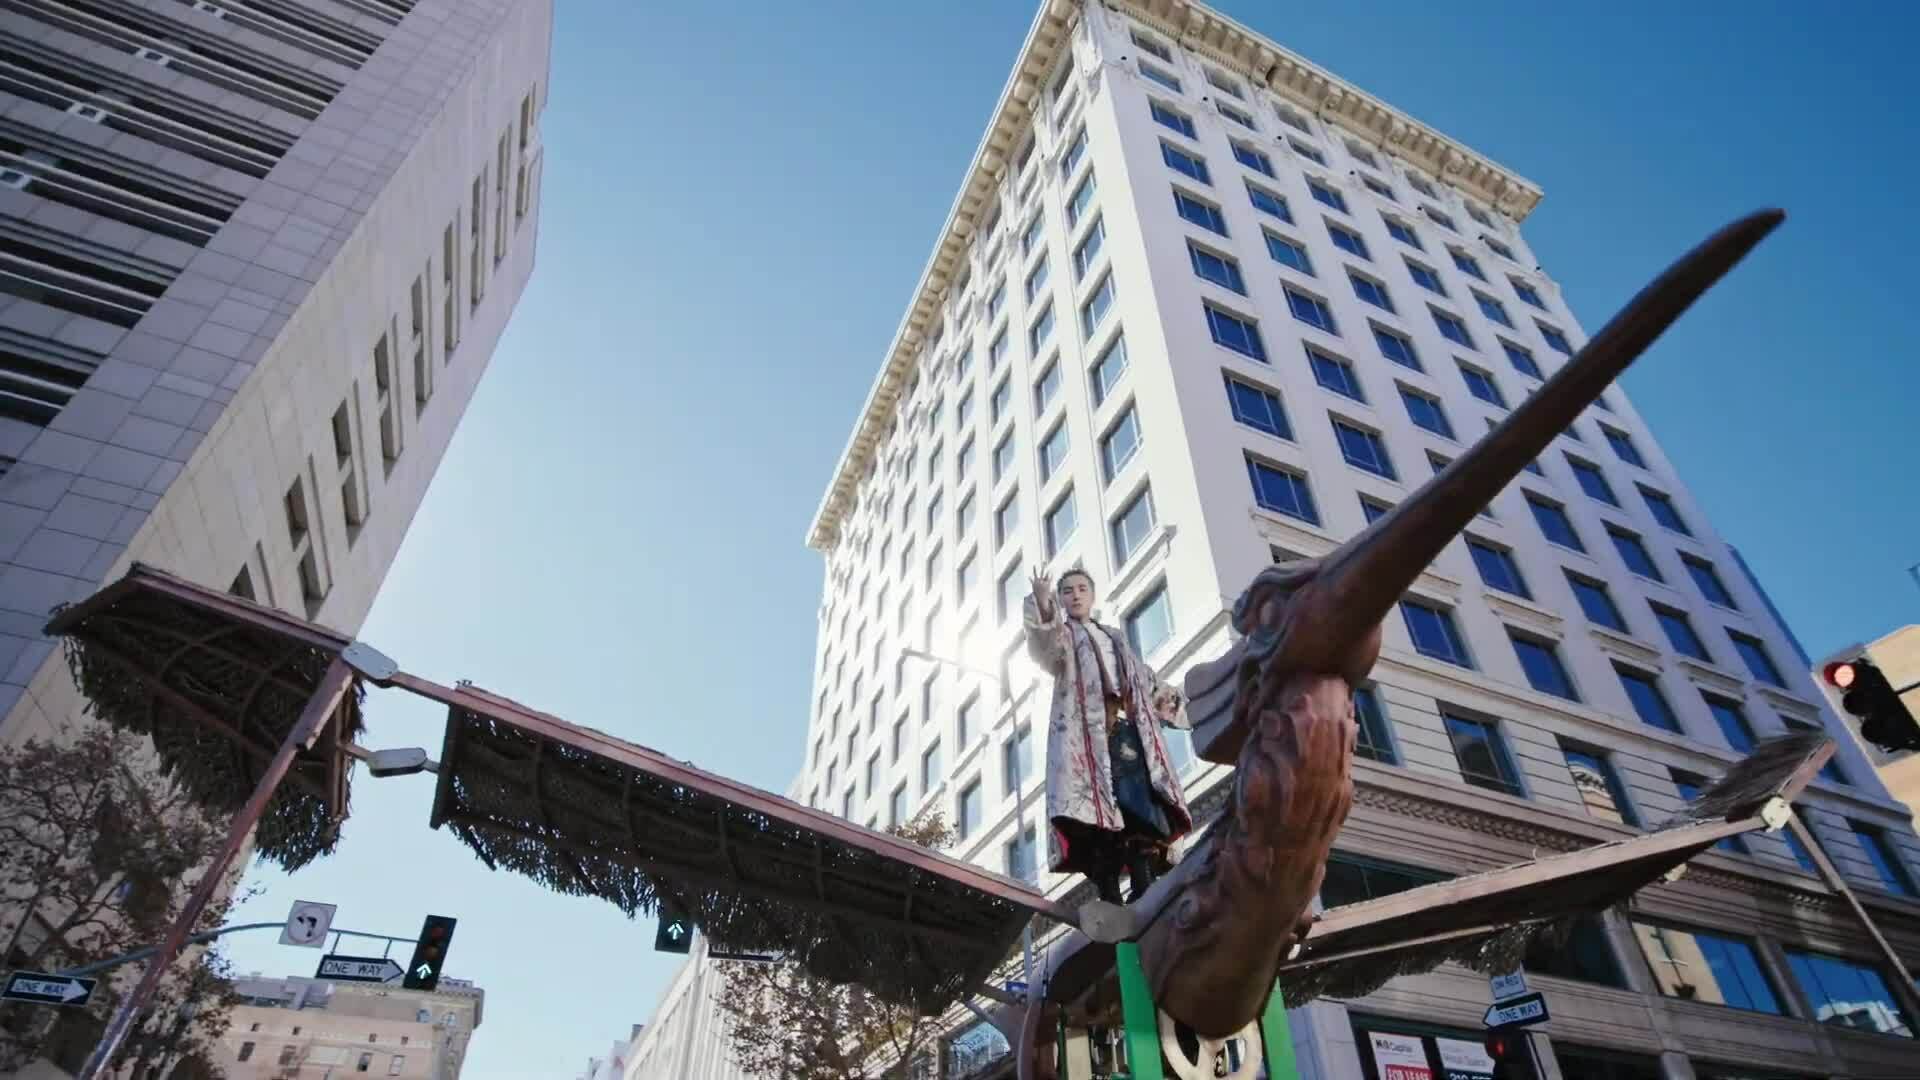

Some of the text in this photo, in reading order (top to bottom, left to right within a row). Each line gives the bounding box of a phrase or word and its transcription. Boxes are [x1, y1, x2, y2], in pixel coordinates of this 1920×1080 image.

[325, 961, 384, 977] ONE WAY
[15, 980, 67, 995] ONE WAY
[1499, 1002, 1539, 1022] ONE WAY
